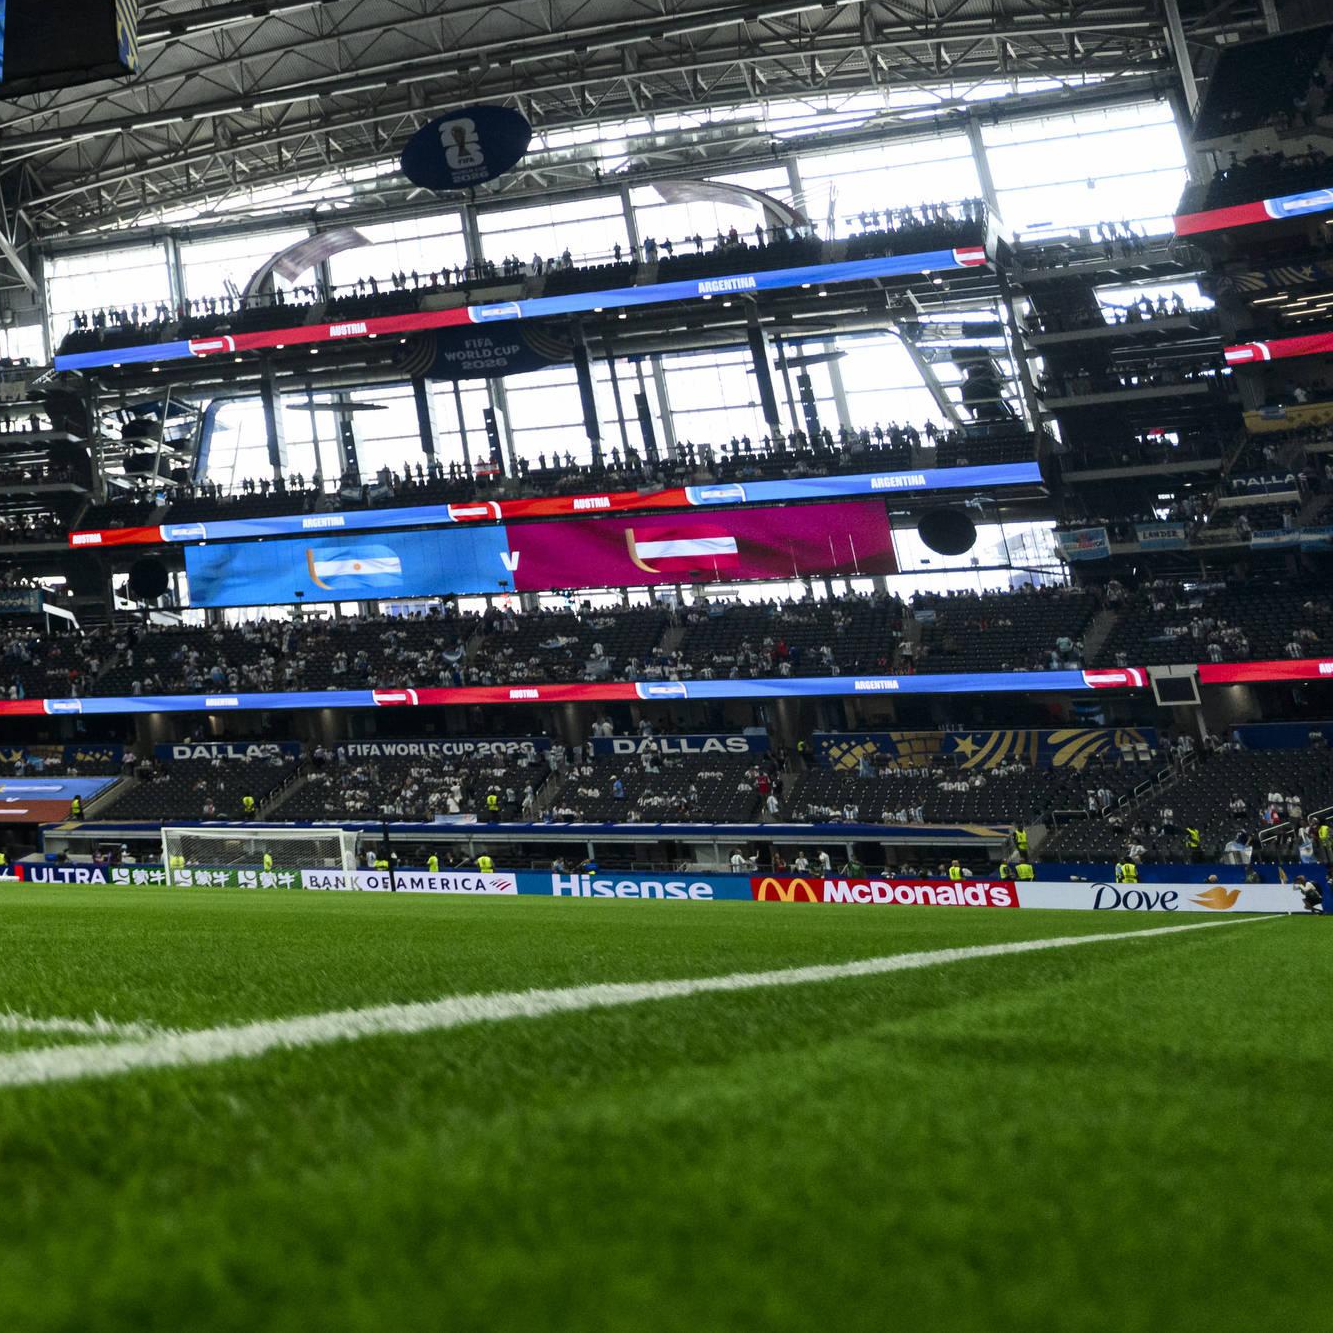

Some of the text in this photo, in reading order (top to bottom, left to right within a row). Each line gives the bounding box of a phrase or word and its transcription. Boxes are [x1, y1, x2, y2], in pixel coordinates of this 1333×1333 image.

[698, 277, 757, 294] ARGENTINA
[329, 322, 367, 337] AUSTRIA
[464, 338, 493, 349] FIFA
[445, 344, 520, 362] WORLD CUP
[461, 358, 508, 370] 2026
[870, 474, 926, 489] ARGENTINA
[573, 497, 610, 510] AUSTRIA
[302, 516, 345, 529] ARGENTINA
[72, 533, 102, 544] AUSTRIA
[854, 680, 899, 690] ARGENTINA
[509, 689, 539, 699] AUSTRIA
[347, 744, 380, 756] FIFA
[383, 743, 442, 756] WORLD
[443, 742, 475, 756] CUP
[613, 738, 749, 755] DALLAS
[31, 867, 107, 884] ULTRA
[309, 875, 361, 891] BANK
[396, 877, 486, 892] AMERICA
[551, 873, 714, 900] Hisense
[823, 880, 1012, 907] McDonald's
[1090, 882, 1179, 911] Dove
